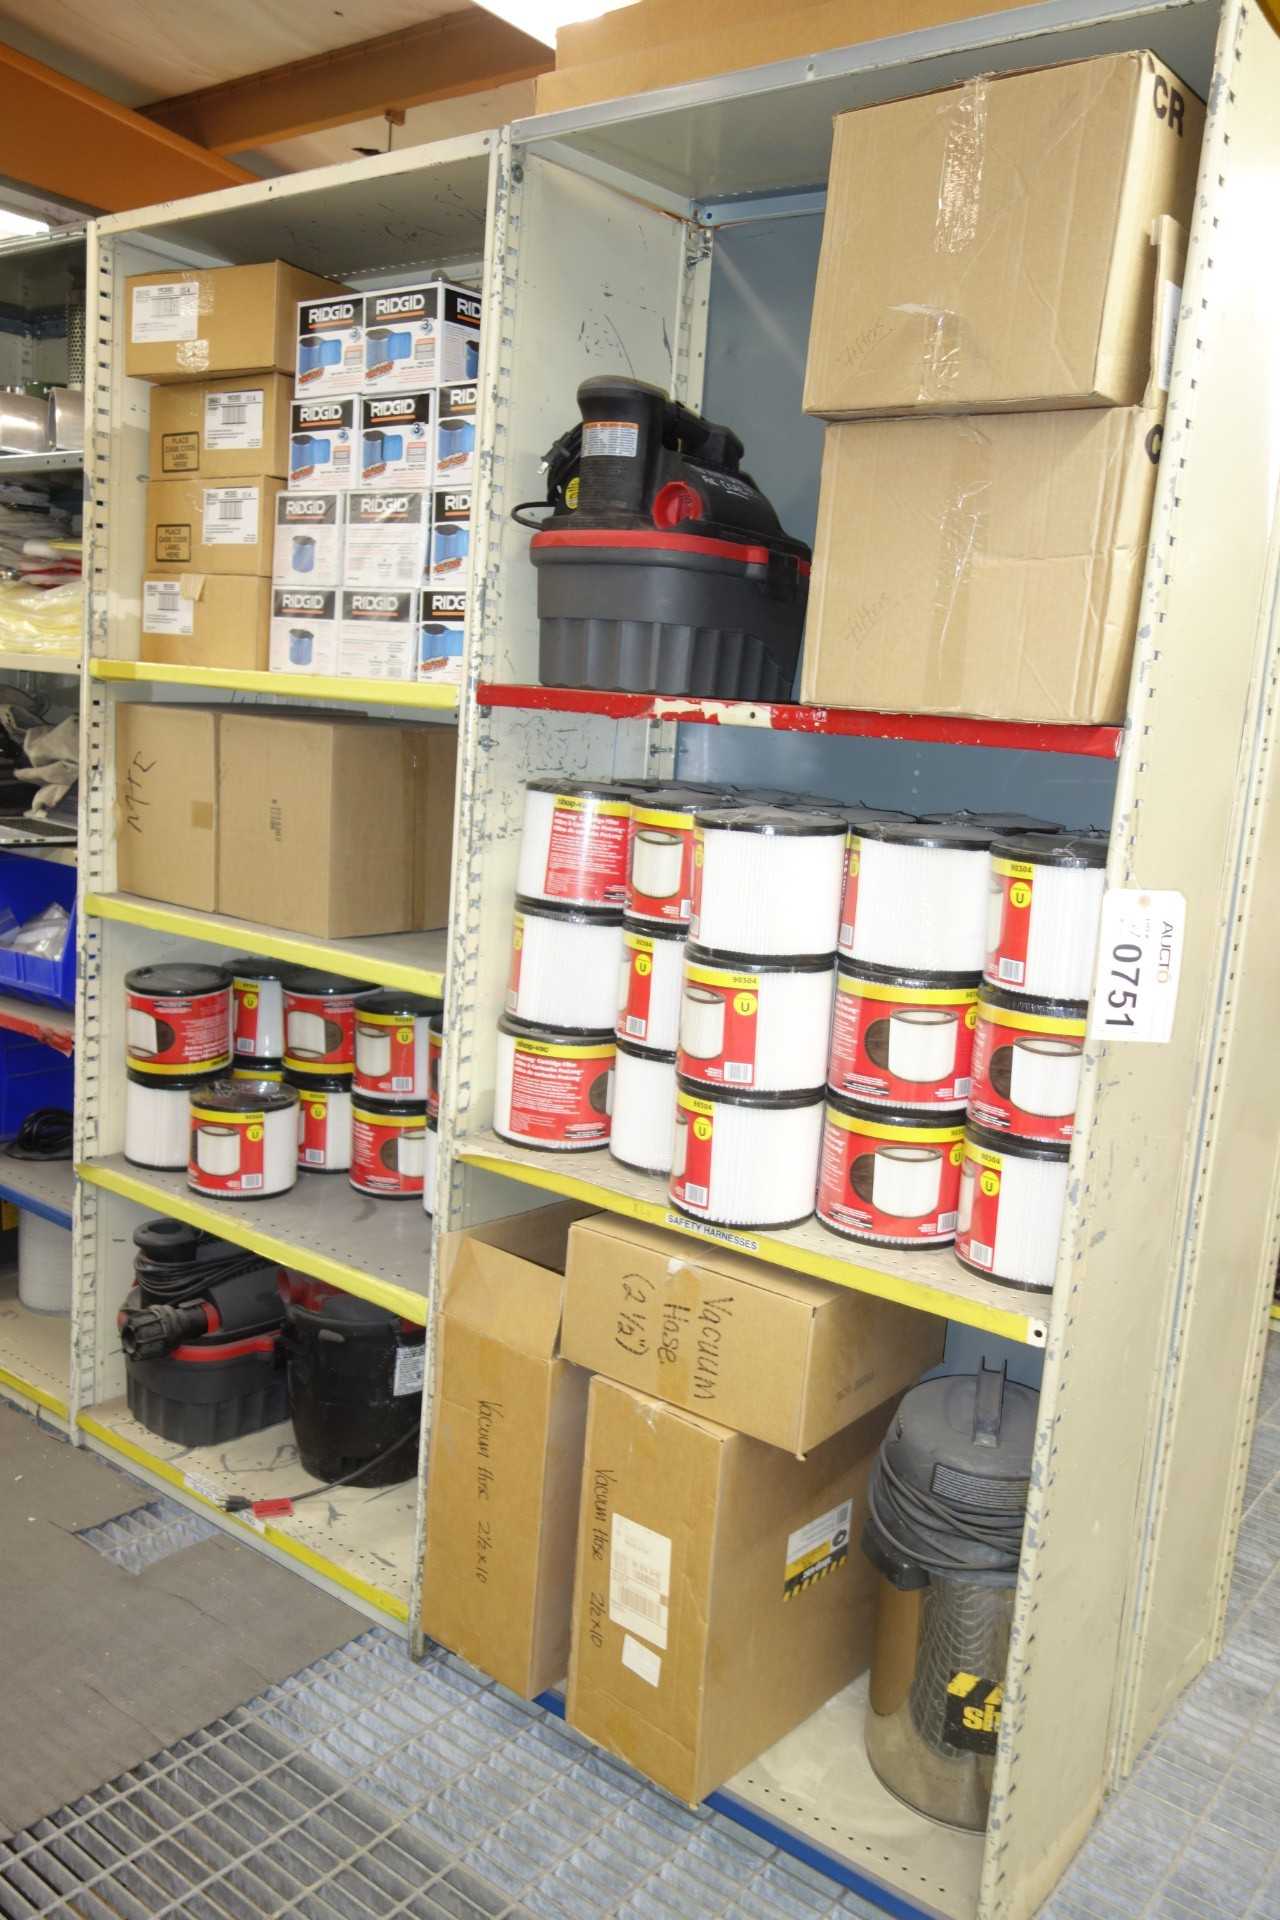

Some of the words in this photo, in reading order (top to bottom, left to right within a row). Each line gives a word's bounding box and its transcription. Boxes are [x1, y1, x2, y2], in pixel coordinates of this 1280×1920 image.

[1153, 74, 1185, 137] CR
[376, 294, 425, 315] RIDGID
[308, 304, 354, 323] RIDGID
[300, 405, 343, 421] RIDGID
[370, 399, 415, 417] RIDGID
[286, 501, 327, 515] RIDGID
[360, 497, 409, 513] RIDGID
[282, 594, 324, 609] RIDGID
[352, 596, 399, 610] RIDGID
[1015, 892, 1025, 904] U
[639, 961, 648, 972] U
[1105, 943, 1142, 1026] 0751
[740, 1000, 750, 1012] U
[698, 1126, 707, 1137] U
[984, 1180, 994, 1192] U
[668, 1214, 701, 1231] SAFETY
[703, 1226, 757, 1250] HARNESSES
[657, 1303, 691, 1364] Hose
[694, 1297, 734, 1399] Vacuum
[593, 1469, 618, 1522] Vacuum
